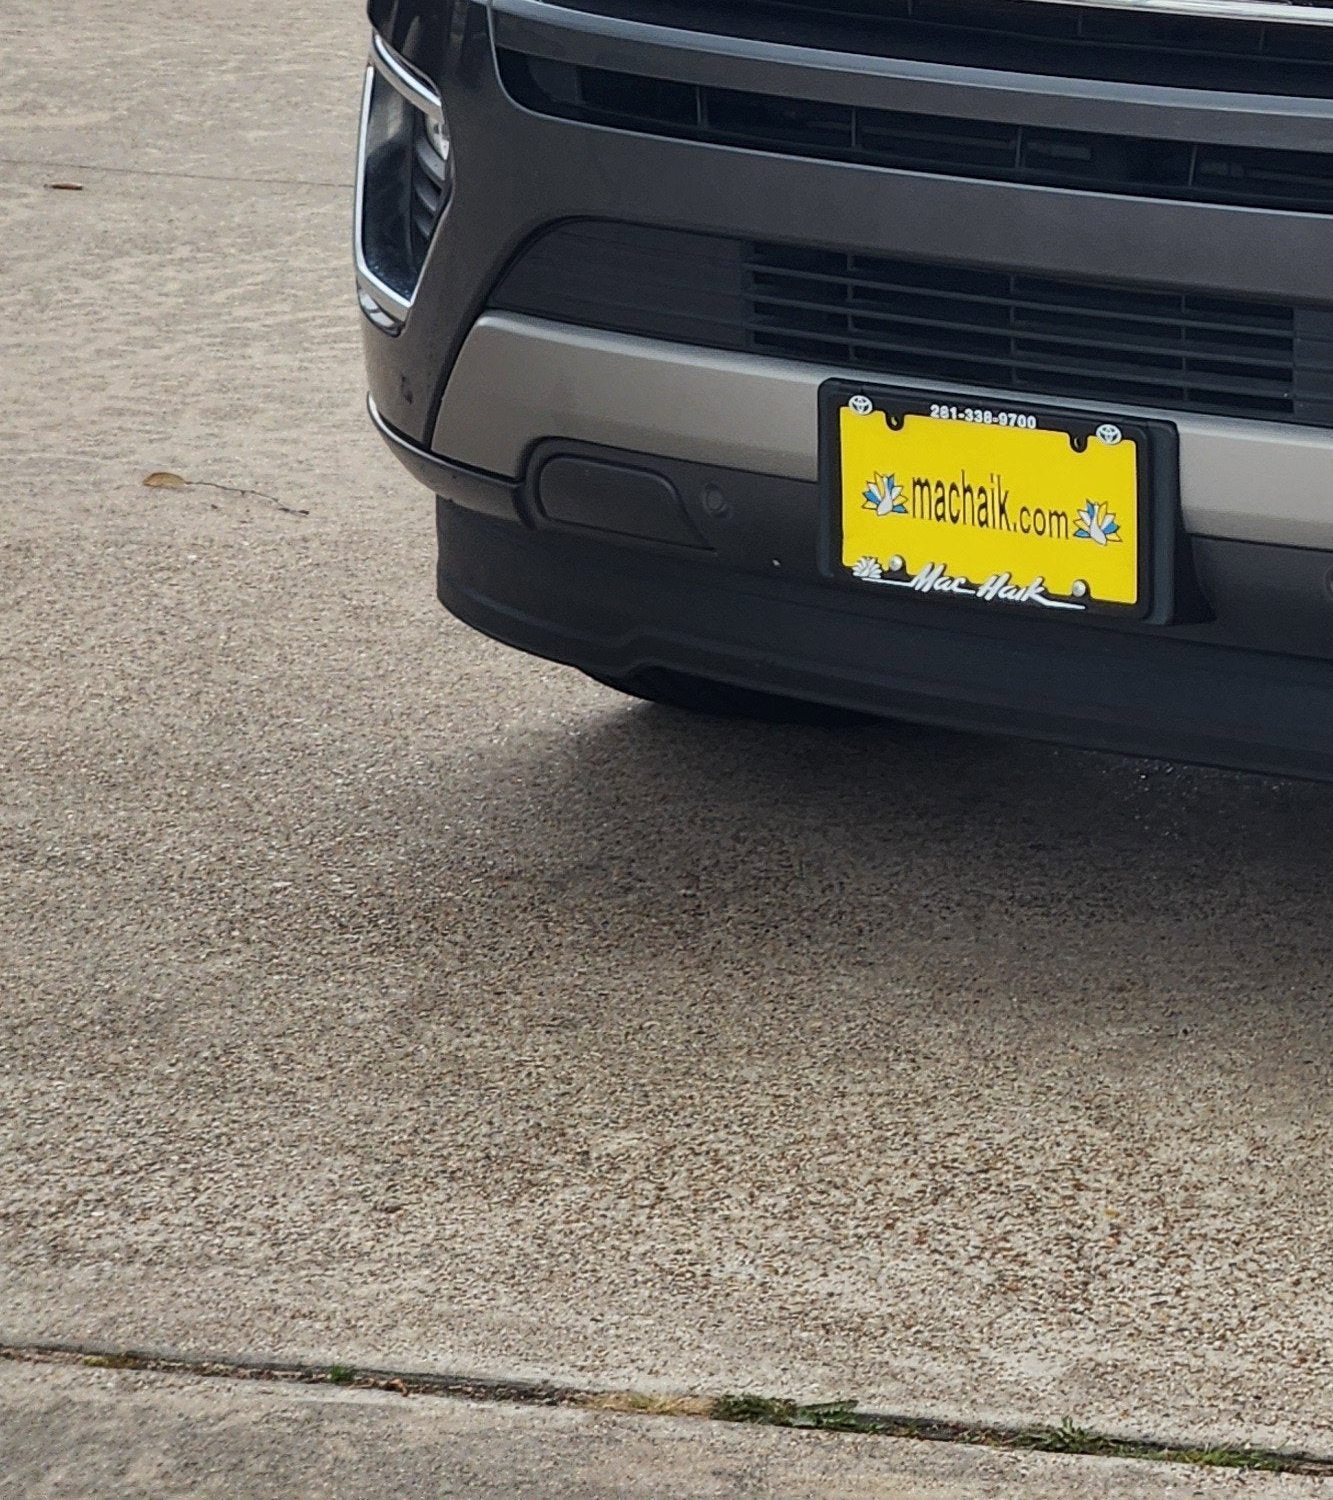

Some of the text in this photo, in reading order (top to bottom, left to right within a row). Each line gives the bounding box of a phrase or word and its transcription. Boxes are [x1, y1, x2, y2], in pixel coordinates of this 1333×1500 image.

[929, 403, 1038, 431] 281-338-9700
[911, 470, 1070, 541] machaik.com
[904, 561, 1056, 606] Mac Haik
